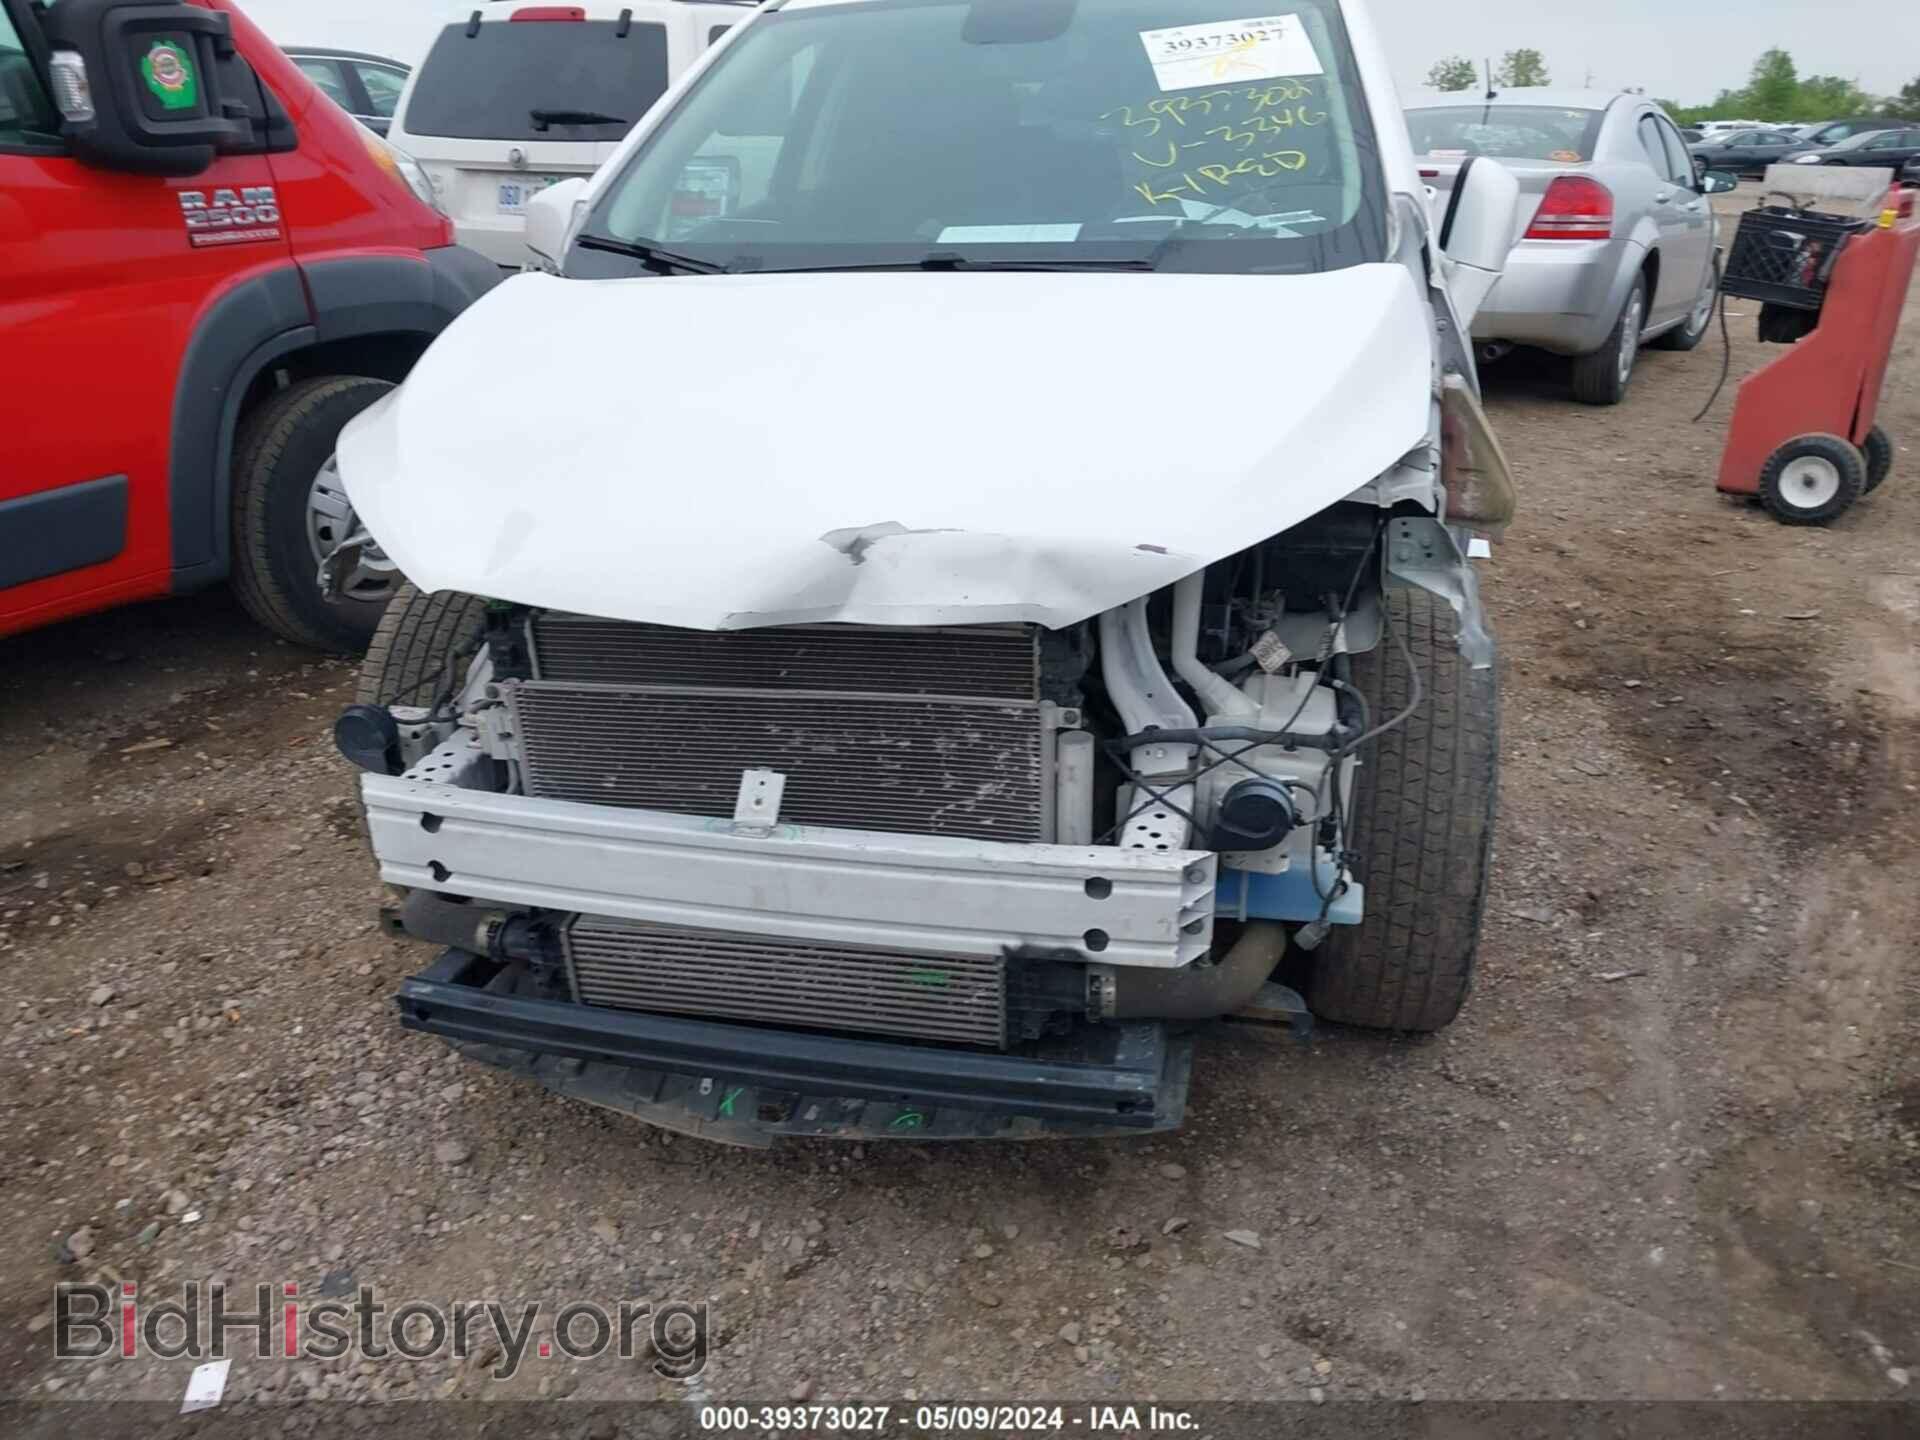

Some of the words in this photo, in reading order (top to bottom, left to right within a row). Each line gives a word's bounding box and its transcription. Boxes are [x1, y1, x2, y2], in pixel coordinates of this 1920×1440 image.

[1163, 27, 1289, 54] 39373027
[178, 187, 276, 209] RAM
[183, 204, 280, 228] 2500
